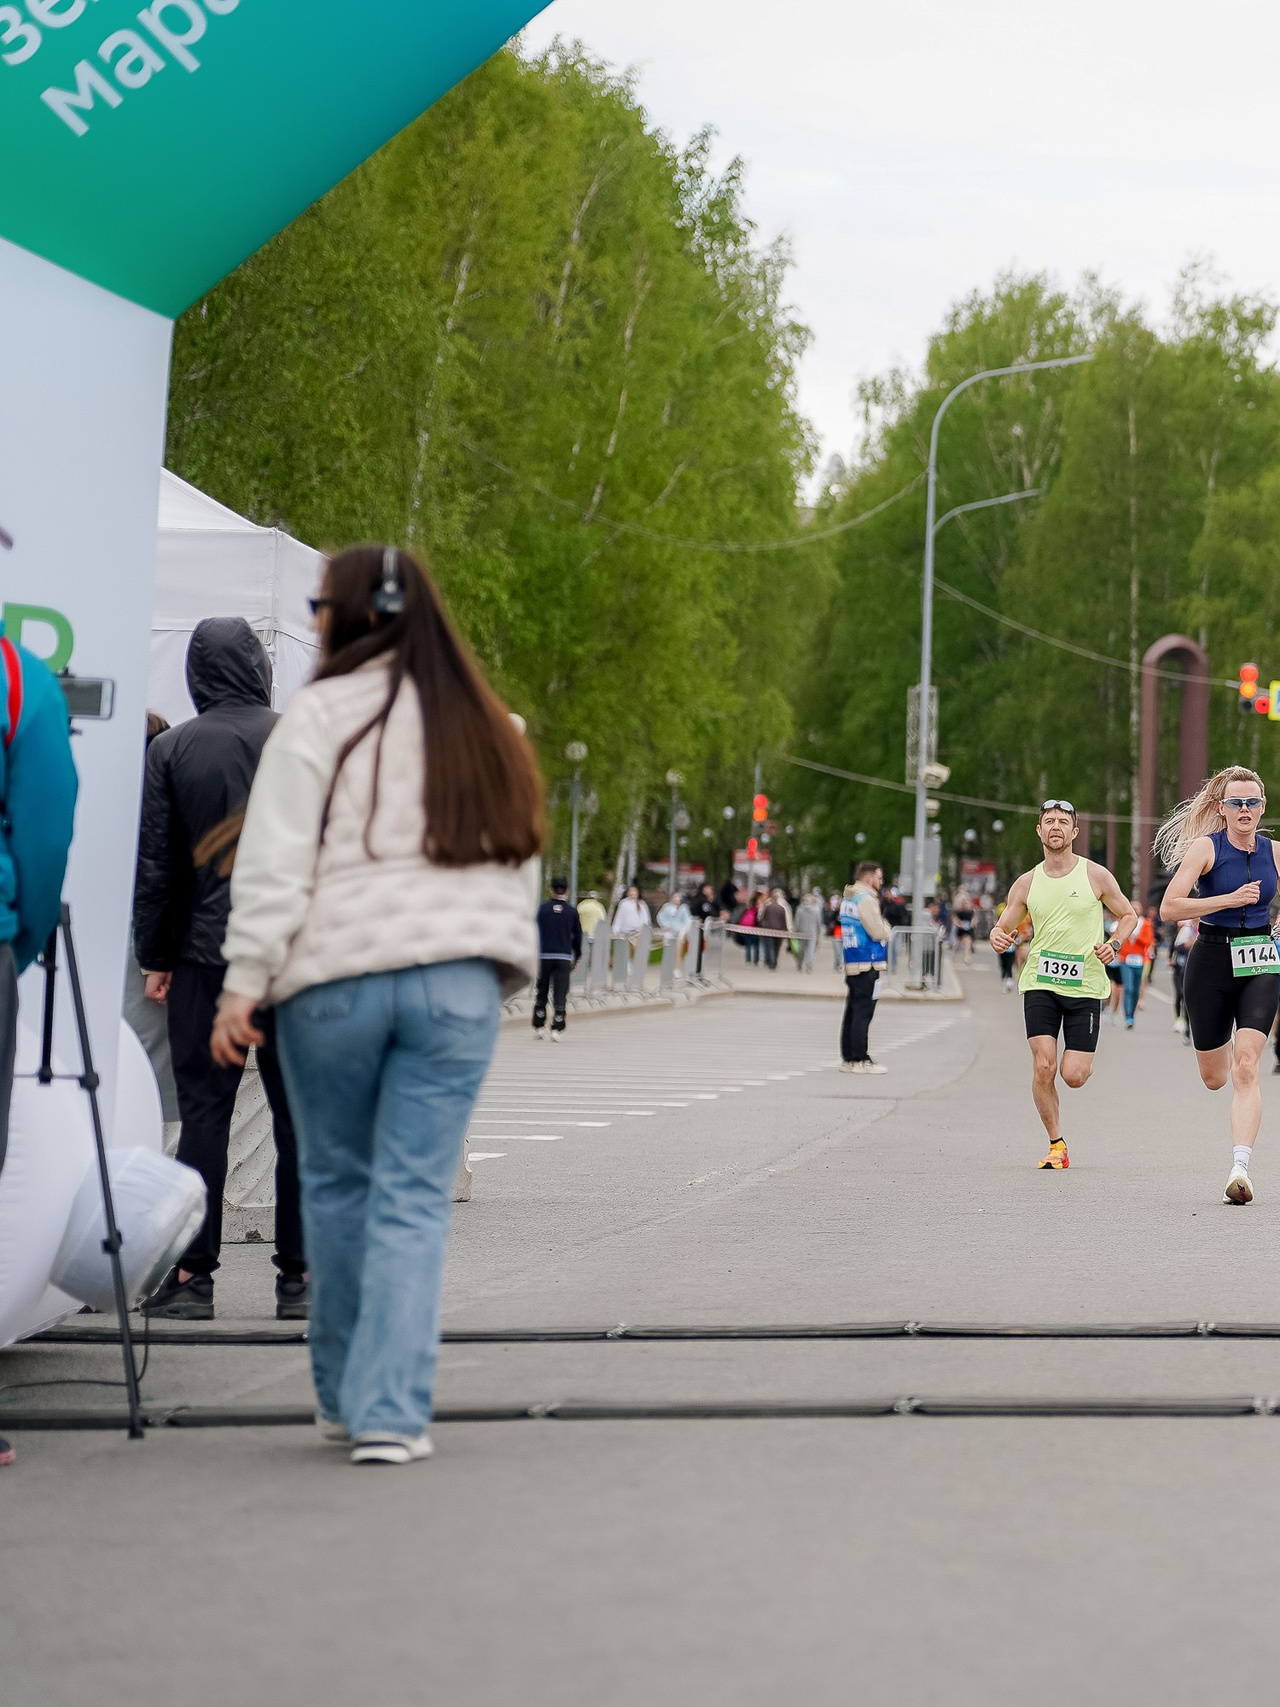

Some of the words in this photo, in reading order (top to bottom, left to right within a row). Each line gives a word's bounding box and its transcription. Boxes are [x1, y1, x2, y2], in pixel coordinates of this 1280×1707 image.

[40, 0, 242, 138] мар
[1237, 946, 1277, 964] 1144
[1043, 960, 1079, 977] 1396
